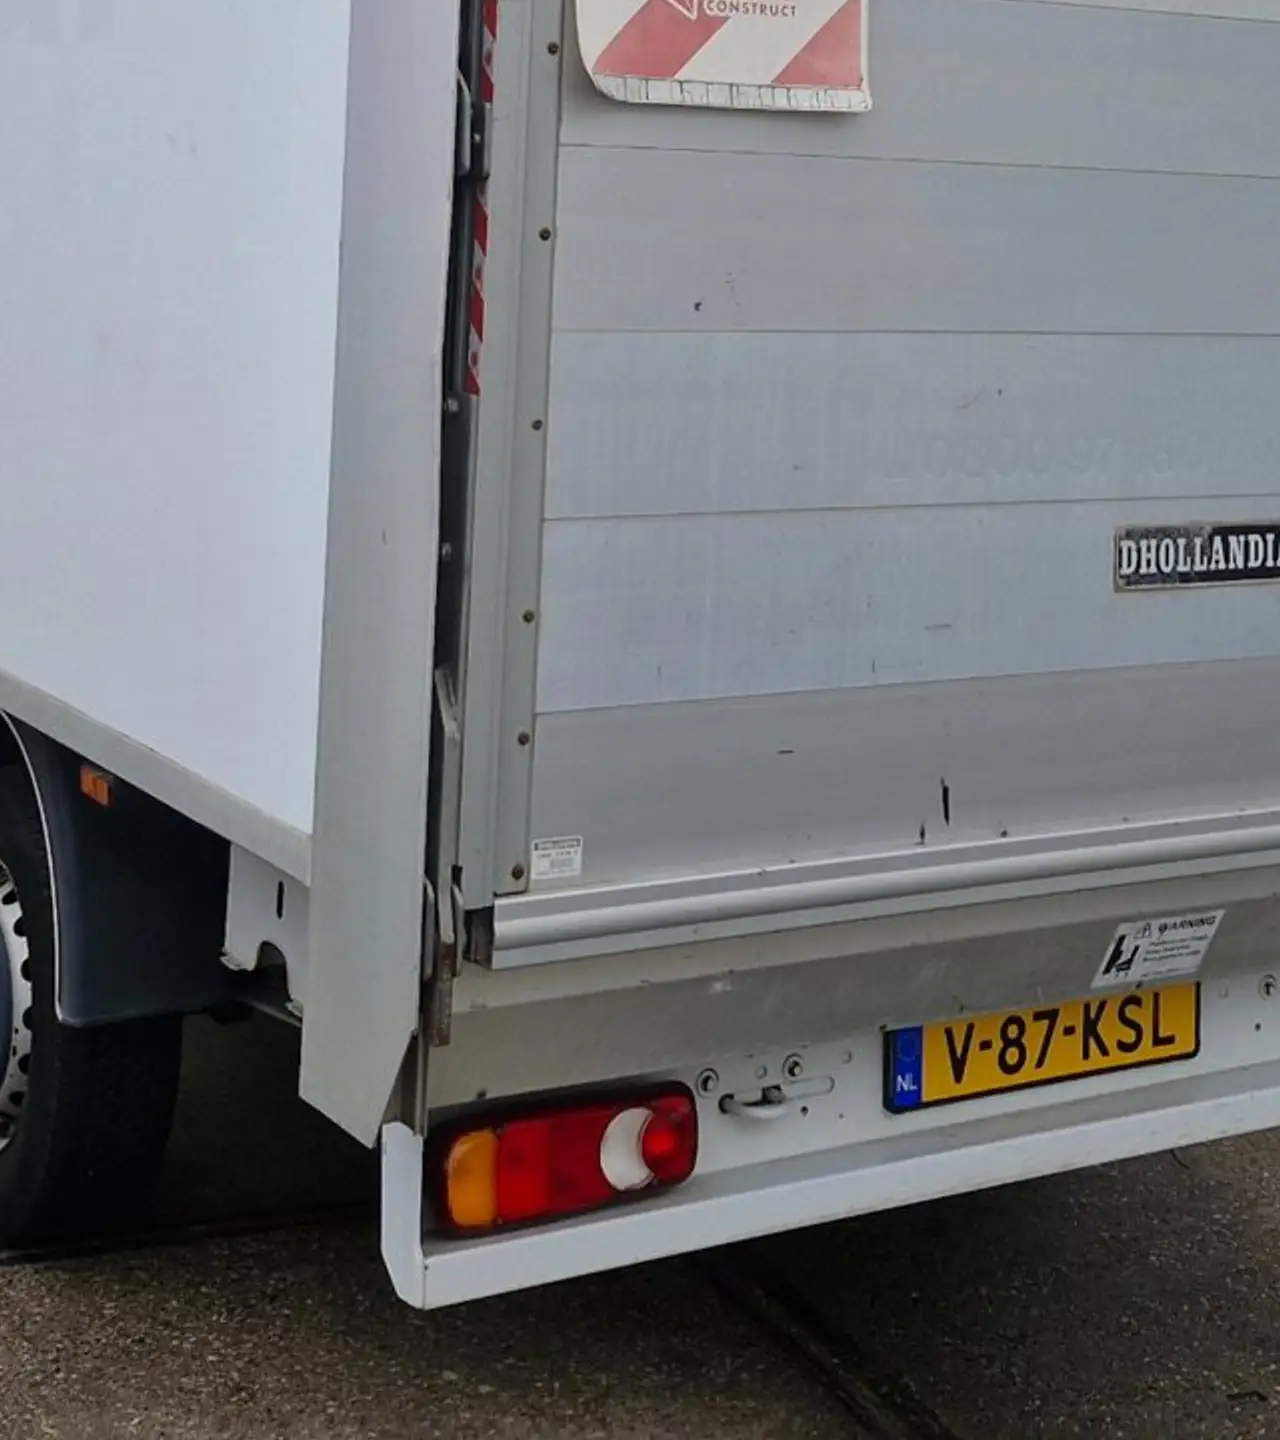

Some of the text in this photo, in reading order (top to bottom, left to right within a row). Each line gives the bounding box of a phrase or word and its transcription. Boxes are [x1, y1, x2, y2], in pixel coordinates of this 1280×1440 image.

[706, 0, 796, 17] CONSTRUCT
[896, 991, 1176, 1093] NL V-87-KSL
